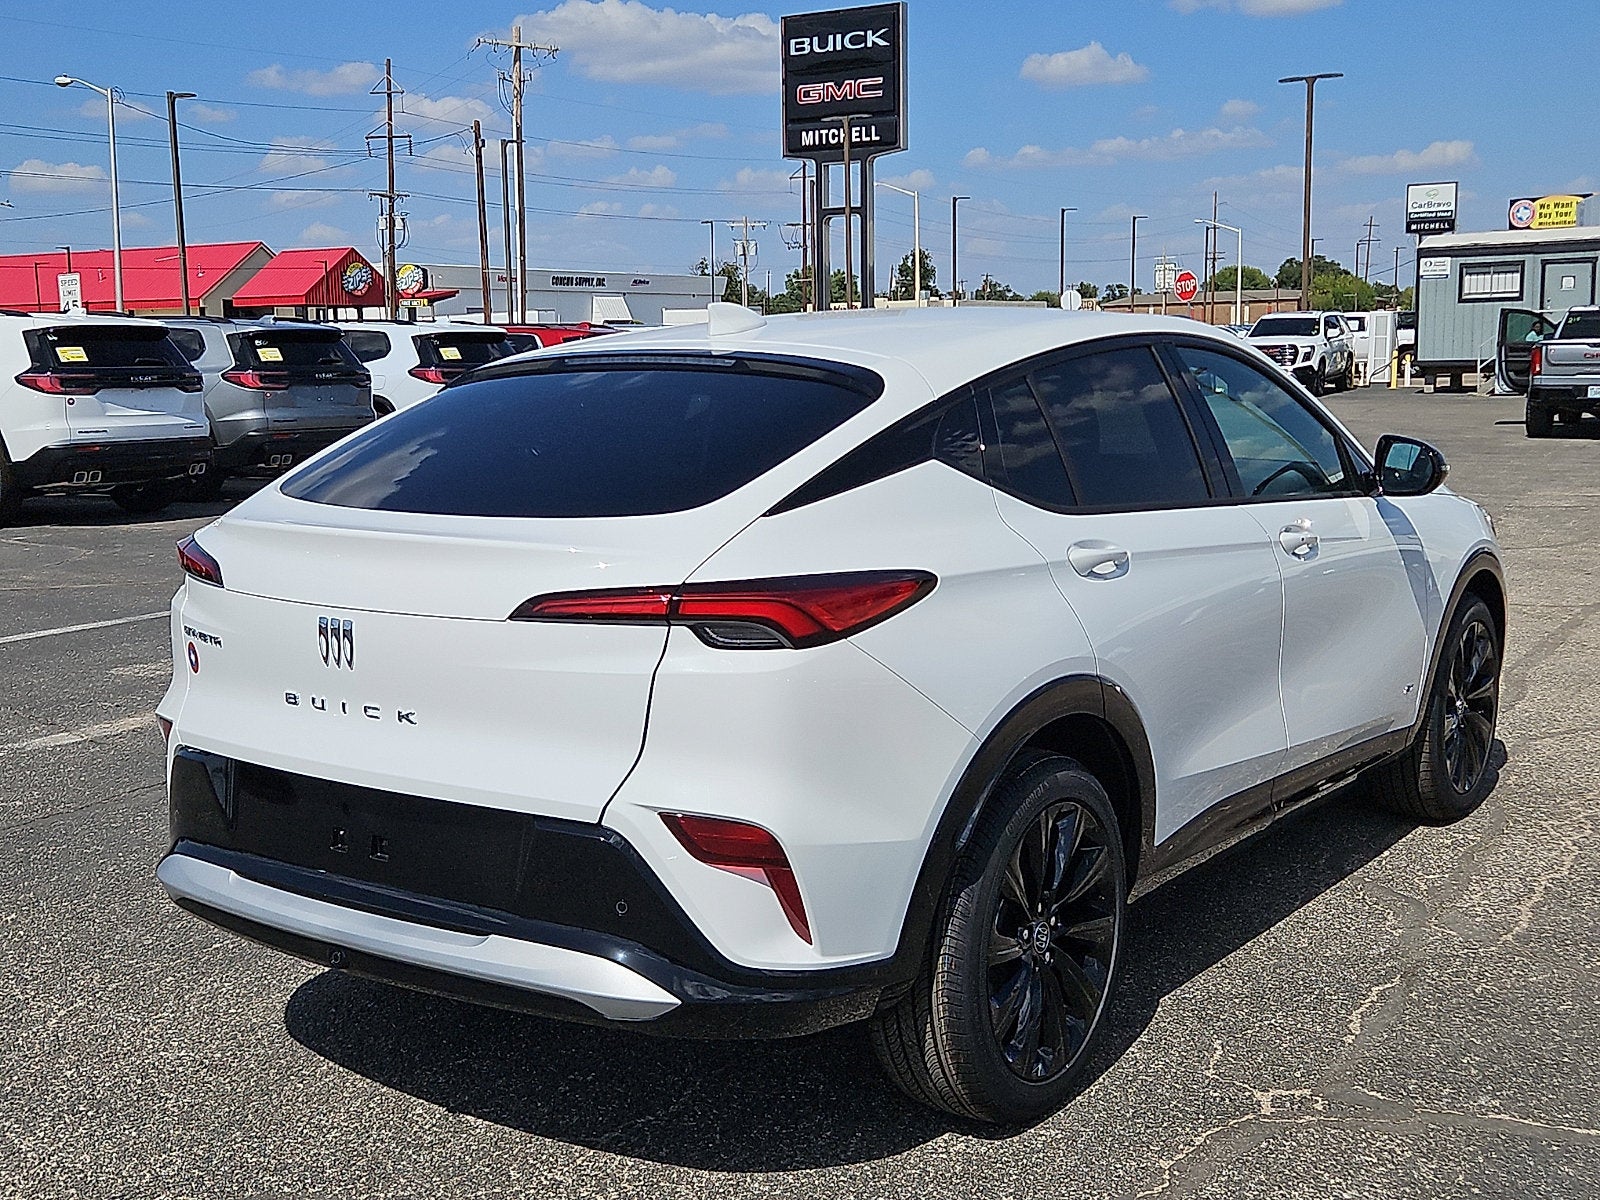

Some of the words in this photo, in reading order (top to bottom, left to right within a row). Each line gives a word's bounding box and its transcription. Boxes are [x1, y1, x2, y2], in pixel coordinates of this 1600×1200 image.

[789, 28, 890, 56] BUICK
[796, 76, 884, 105] GMC
[1411, 200, 1452, 209] CarBravo
[1539, 202, 1551, 210] We
[1553, 201, 1573, 209] Want
[1538, 211, 1552, 220] Buy
[1555, 210, 1572, 218] Your
[1411, 222, 1450, 231] MITCHELL
[61, 279, 78, 287] SPEED
[347, 268, 368, 289] ZIPS
[399, 269, 421, 290] ZIPS
[1176, 278, 1196, 293] STOP
[63, 289, 77, 297] LIMIT
[64, 299, 79, 310] 45
[285, 691, 418, 726] BUICK
